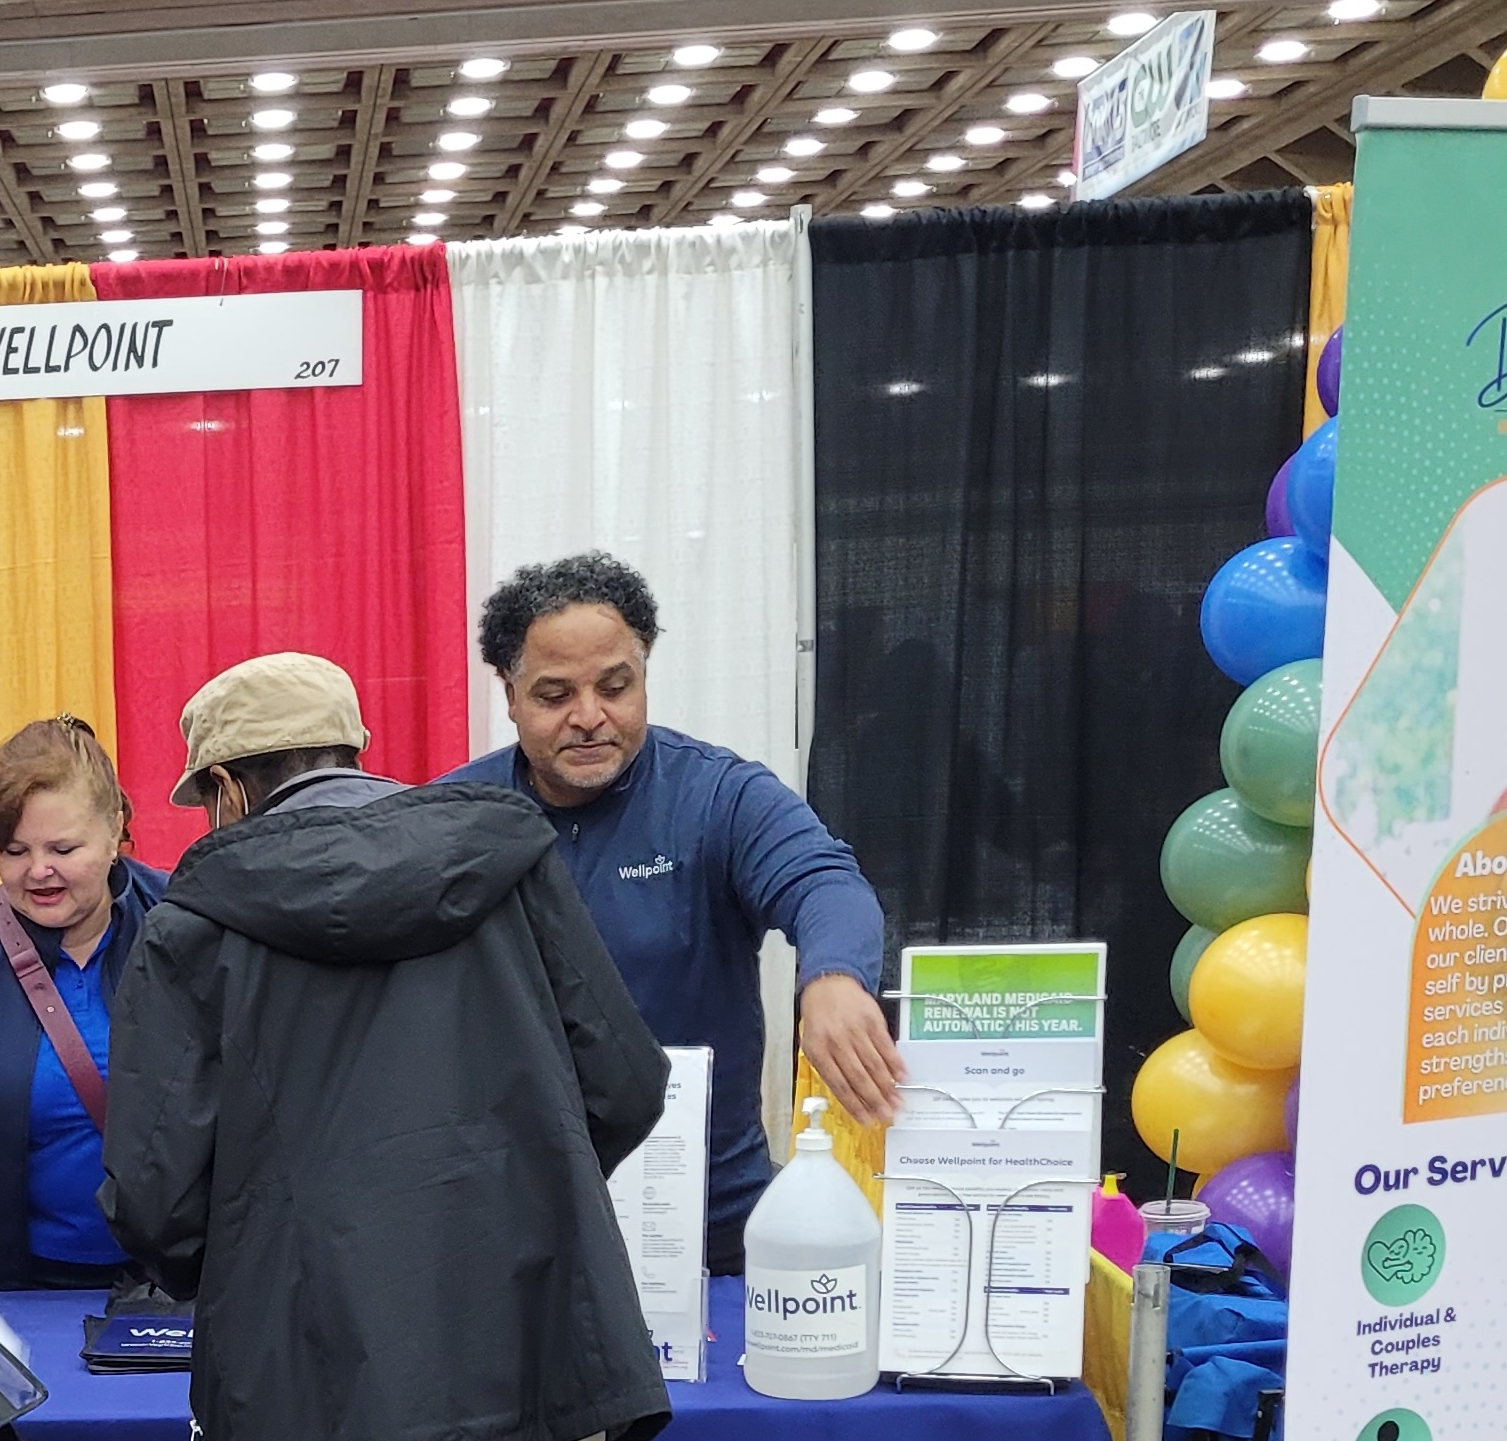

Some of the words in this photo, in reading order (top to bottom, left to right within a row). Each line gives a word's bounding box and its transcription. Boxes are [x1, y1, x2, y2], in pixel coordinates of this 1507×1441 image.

[294, 358, 340, 380] 207
[618, 860, 674, 880] Wellpoint
[1455, 850, 1507, 878] Abo
[1429, 895, 1463, 916] We
[1428, 918, 1488, 943] whole.
[1426, 950, 1460, 970] our
[1424, 971, 1462, 996] self
[1465, 971, 1489, 996] by
[924, 1006, 991, 1018] RENEWAL
[993, 1006, 1007, 1017] IS
[1422, 998, 1504, 1022] services
[923, 1019, 1004, 1032] AUTOMATIC
[1041, 1019, 1083, 1031] YEAR.
[1422, 1024, 1469, 1050] each
[1473, 1020, 1507, 1042] indi
[964, 1066, 989, 1075] Scan
[991, 1066, 1010, 1075] and
[1013, 1069, 1025, 1077] go
[1420, 1047, 1507, 1076] strength
[1418, 1076, 1507, 1106] preferen
[899, 1156, 936, 1166] Choose
[937, 1157, 986, 1167] Wellpoint
[988, 1157, 1003, 1166] for
[1005, 1157, 1074, 1167] HealthChoice
[1354, 1164, 1419, 1195] Our
[1356, 1308, 1440, 1336] Individual
[1443, 1307, 1457, 1323] &
[1370, 1333, 1441, 1356] Couples
[1368, 1355, 1442, 1379] Therapy
